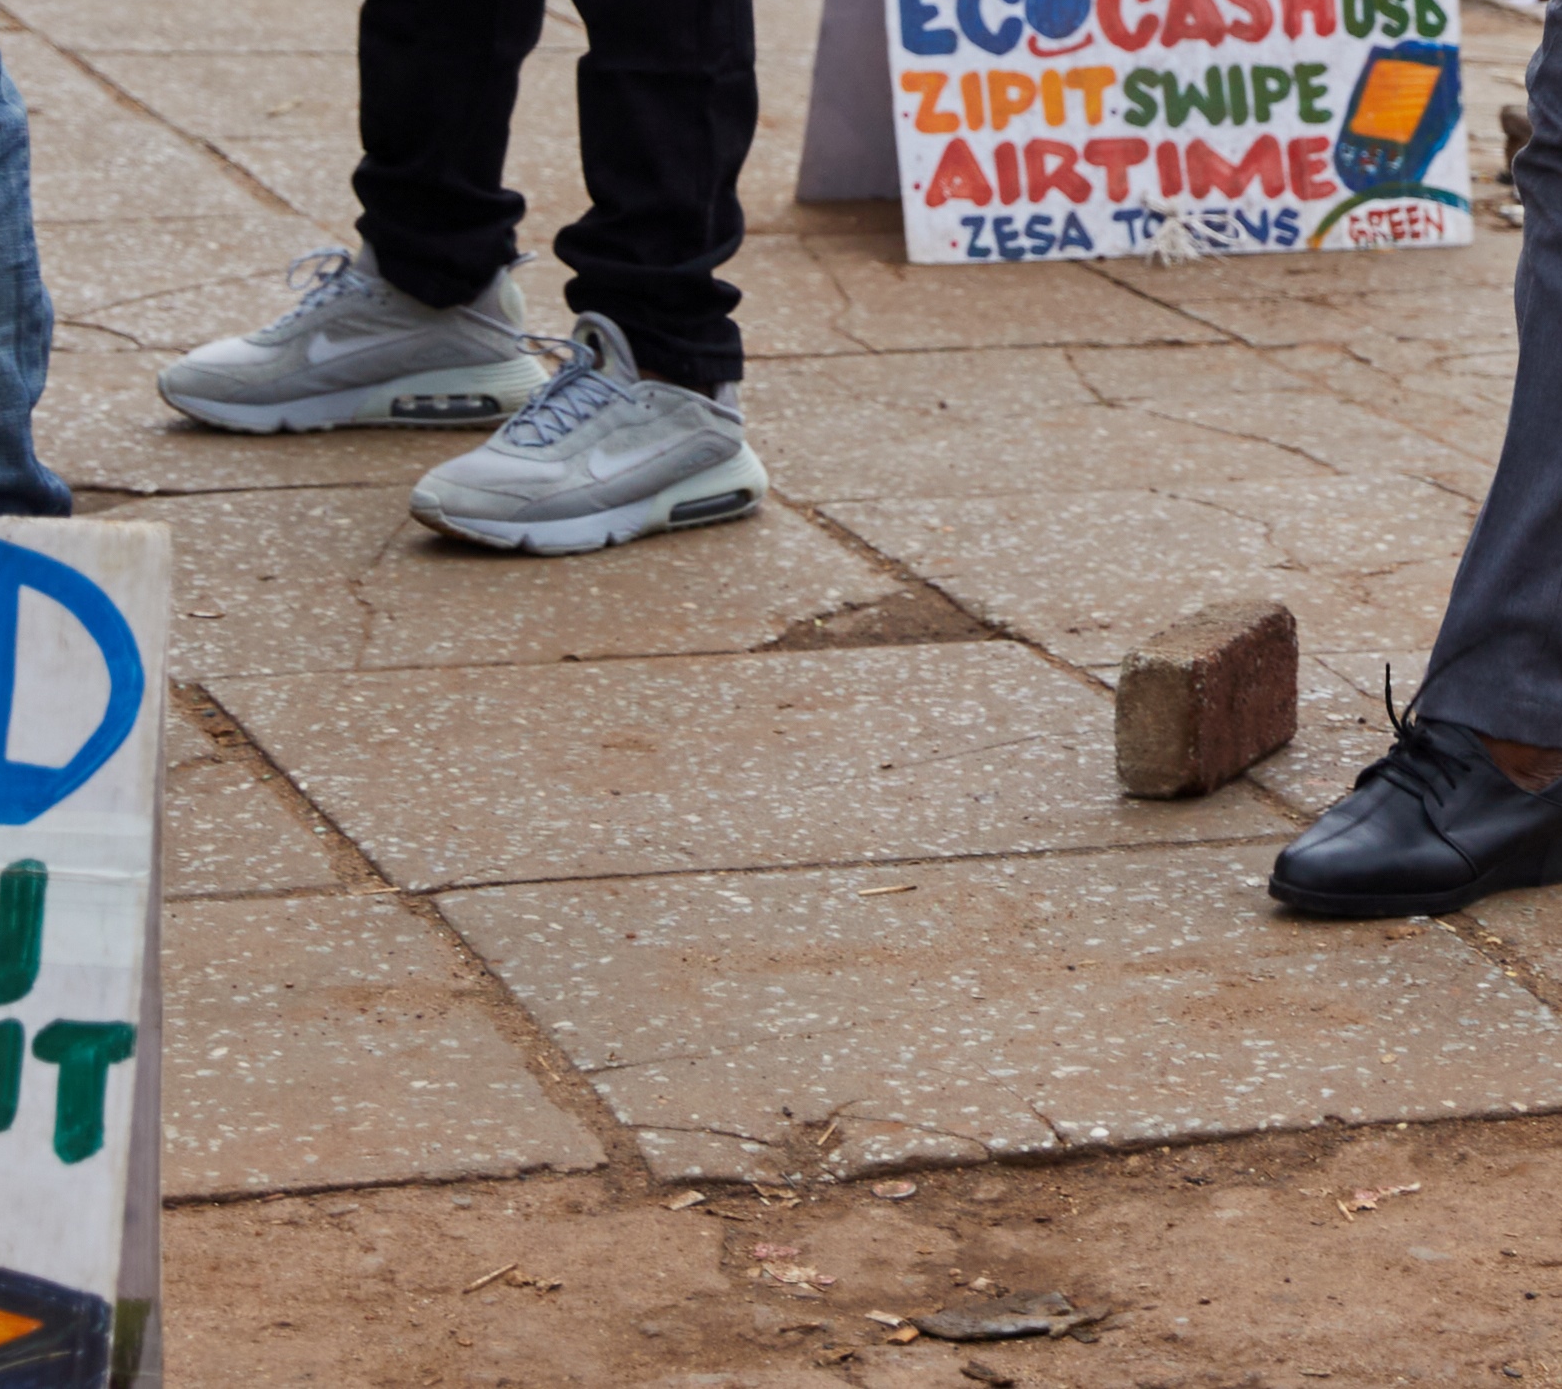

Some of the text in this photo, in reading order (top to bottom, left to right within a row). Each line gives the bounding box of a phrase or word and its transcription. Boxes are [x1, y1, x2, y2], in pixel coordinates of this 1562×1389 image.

[900, 61, 1333, 134] ZIPIT SWIPE
[923, 136, 1338, 208] AIRTIME
[961, 205, 1302, 259] ZESA TOENS
